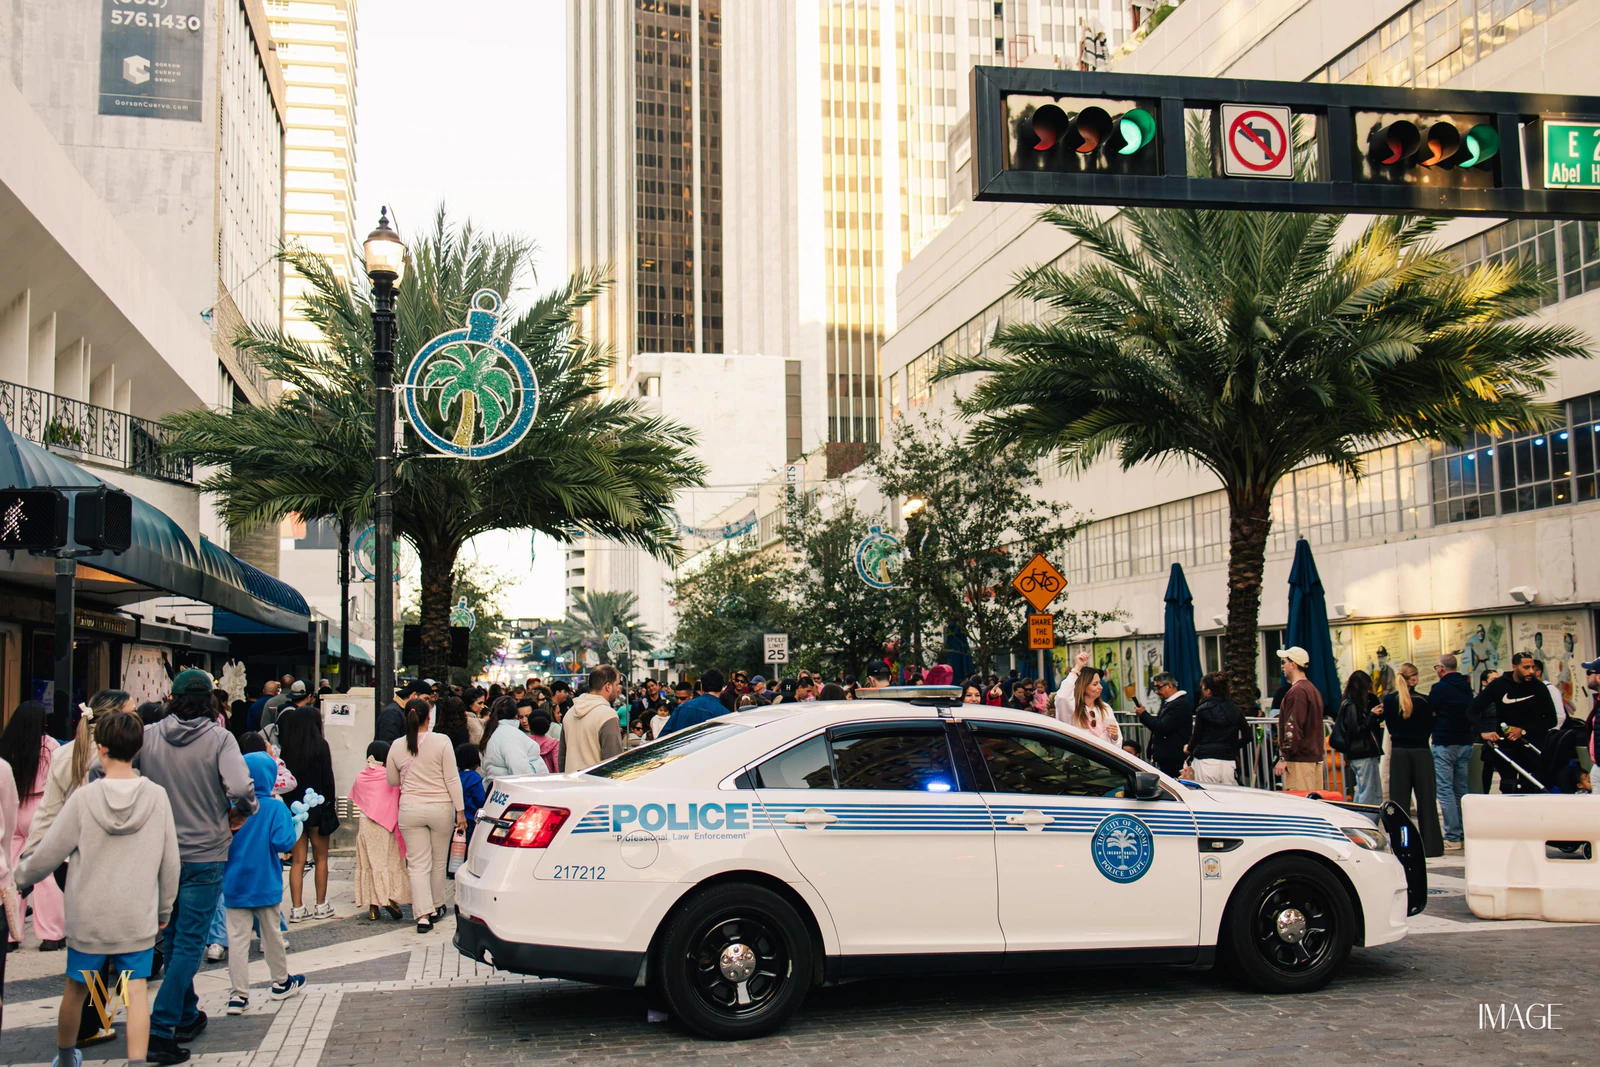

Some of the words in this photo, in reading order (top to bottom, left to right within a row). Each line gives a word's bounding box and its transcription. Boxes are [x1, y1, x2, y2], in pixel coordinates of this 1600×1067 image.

[111, 9, 201, 31] 576.1430
[114, 99, 189, 111] GorsonCuervo.com
[1568, 131, 1580, 158] E
[1551, 162, 1581, 183] Abel
[768, 649, 785, 660] 25
[612, 802, 750, 833] POLICE
[672, 832, 690, 841] Law
[1097, 832, 1106, 846] THE
[1105, 819, 1120, 831] CITY
[1135, 825, 1148, 847] MIAMI
[553, 864, 606, 880] 217212
[1101, 860, 1125, 877] POLICE
